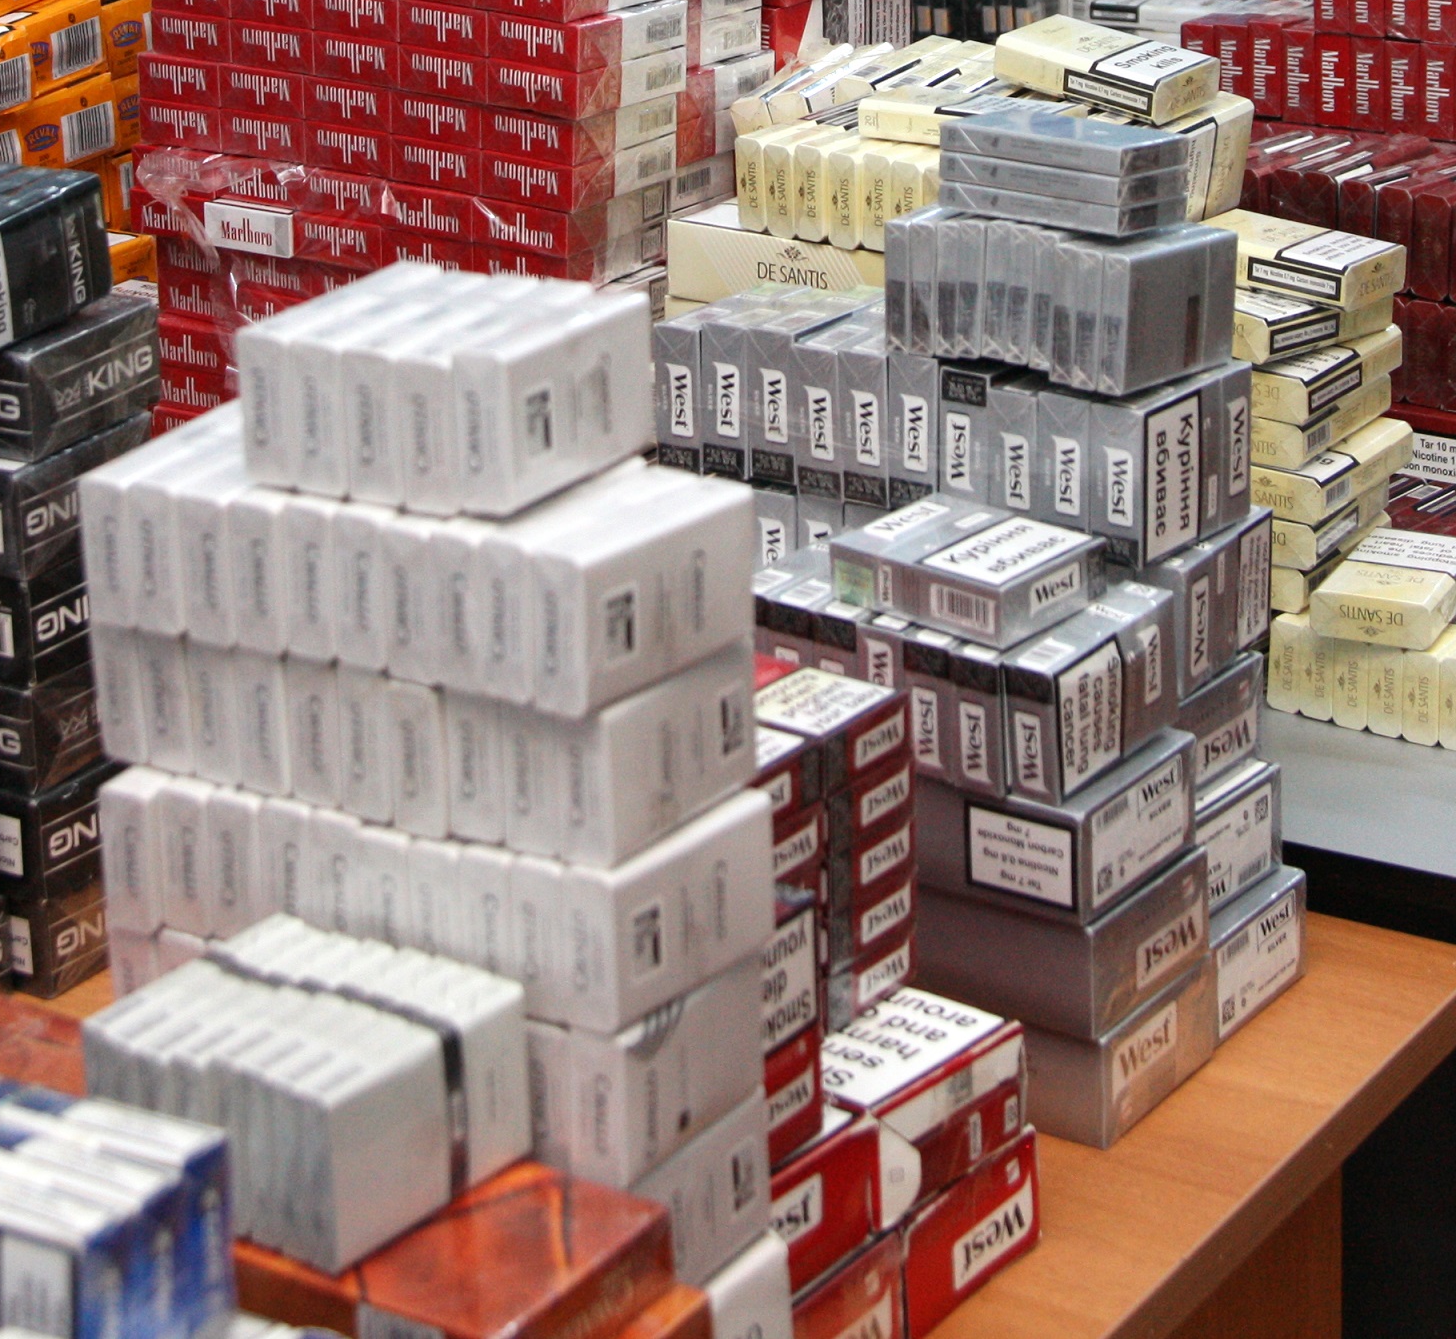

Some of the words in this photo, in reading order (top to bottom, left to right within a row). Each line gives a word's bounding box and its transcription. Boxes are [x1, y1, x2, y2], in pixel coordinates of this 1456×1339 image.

[1114, 44, 1178, 70] Smoking
[1154, 57, 1183, 70] kills
[1321, 49, 1344, 113] Marlboro
[748, 161, 757, 192] SANTIS
[221, 218, 273, 247] Marlboro
[488, 212, 554, 249] Marlboro
[68, 242, 86, 303] KING
[757, 262, 776, 282] DE
[780, 265, 828, 290] SANTIS
[86, 344, 153, 397] KING
[161, 377, 220, 408] Marlboro
[673, 373, 689, 431] West
[812, 396, 828, 453] West
[950, 423, 967, 481] West
[1231, 406, 1245, 485] West
[1412, 450, 1448, 464] Nicotine
[1420, 439, 1433, 449] Tar
[1437, 442, 1446, 452] 10
[1111, 458, 1129, 520] West
[1155, 430, 1170, 539] вбиває
[1177, 413, 1194, 532] Куріння
[946, 522, 1034, 565] Куріння
[1035, 570, 1075, 605] West
[1339, 604, 1384, 622] SANTIS
[1386, 612, 1404, 626] DE
[1079, 672, 1090, 722] fatal
[1093, 676, 1103, 752] causes
[1105, 657, 1120, 752] Smoking
[918, 697, 938, 762] West
[1015, 722, 1038, 782] West
[1063, 697, 1075, 768] cancer
[1077, 723, 1090, 774] lung
[1141, 768, 1177, 803] West
[1149, 799, 1172, 822] SILVER
[1143, 915, 1197, 973] West
[1259, 903, 1292, 936] West
[1267, 931, 1287, 955] SILVER
[1119, 1016, 1173, 1076] West
[960, 1200, 1027, 1273] West
